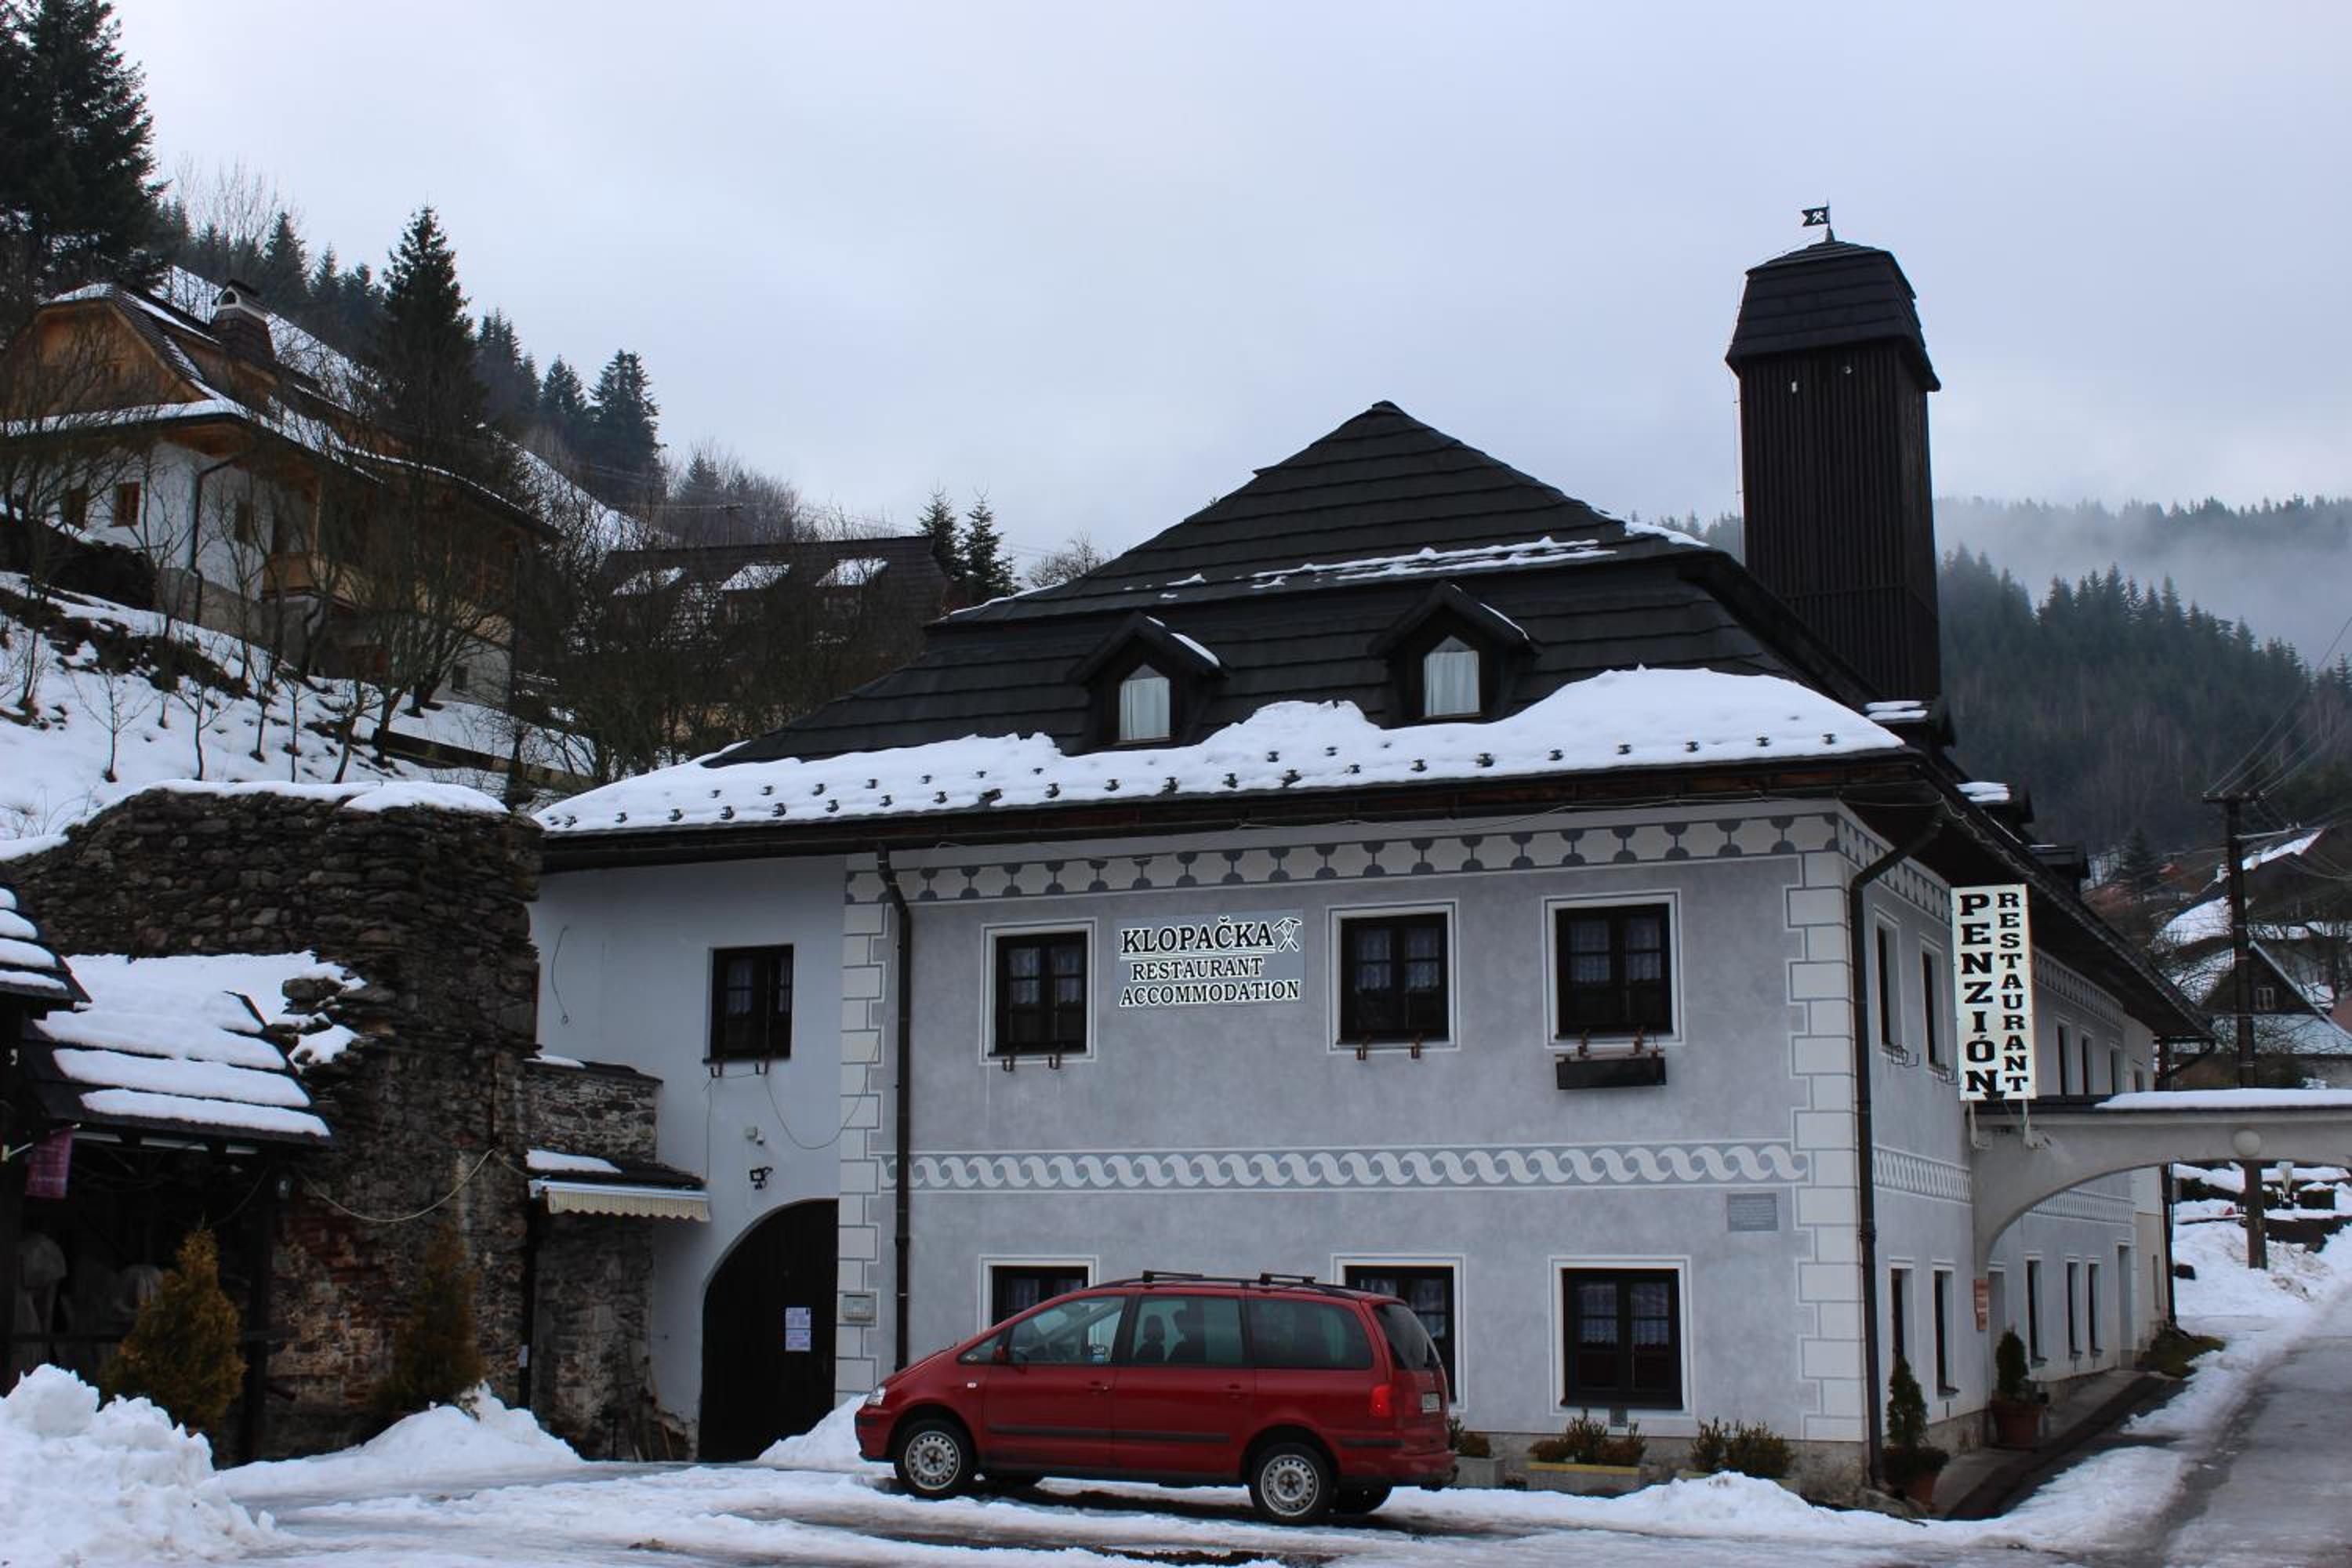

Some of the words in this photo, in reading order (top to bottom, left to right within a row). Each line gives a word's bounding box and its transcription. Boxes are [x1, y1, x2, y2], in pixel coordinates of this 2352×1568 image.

[1122, 917, 1275, 954] KLOPAČKA
[1132, 956, 1262, 982] RESTAURANT
[1120, 980, 1300, 1007] ACCOMMODATION
[1959, 893, 1998, 1093] PENZIÓN
[1998, 892, 2028, 1092] RESTAURANT
